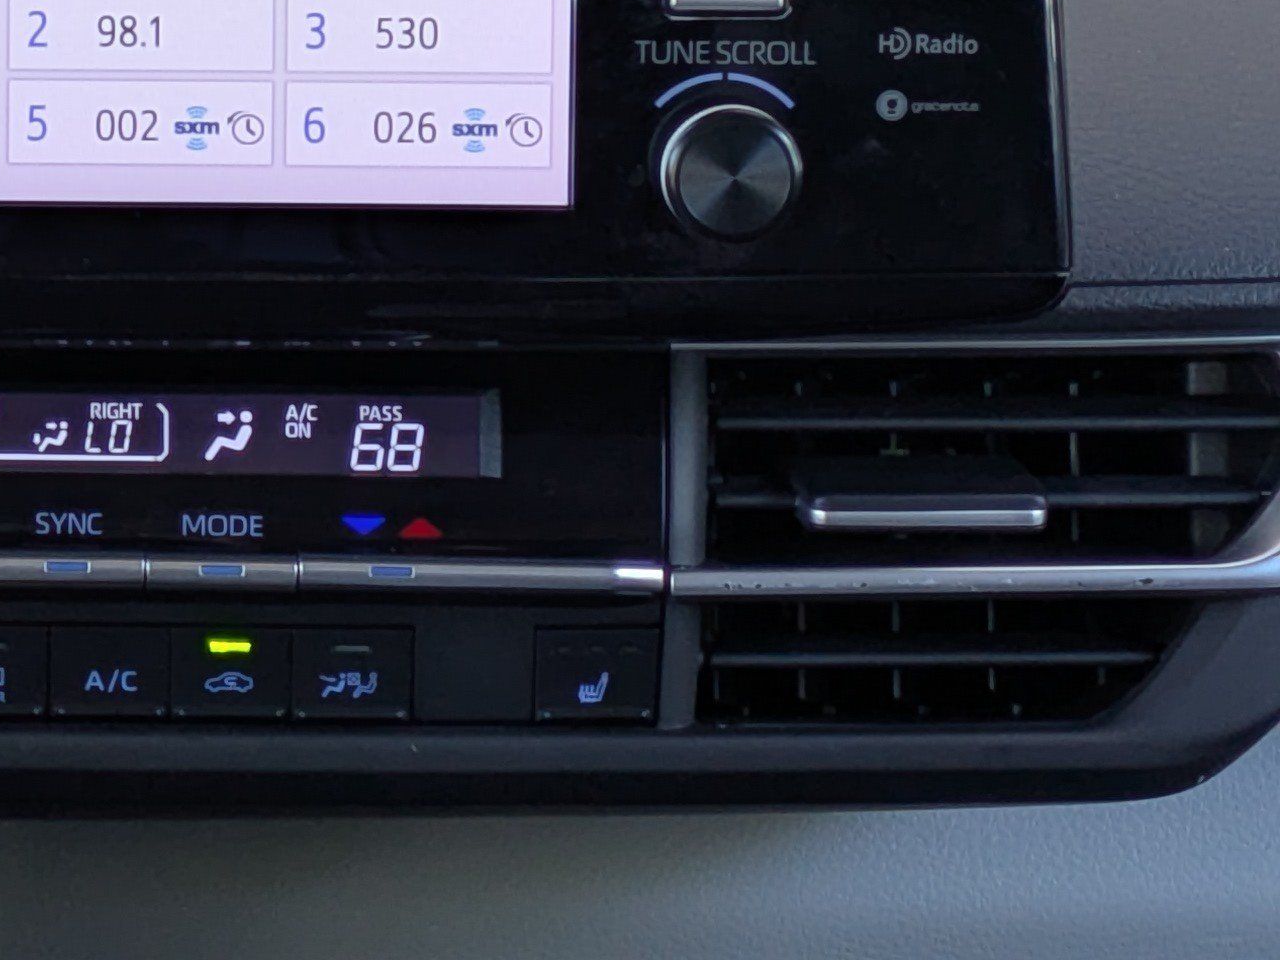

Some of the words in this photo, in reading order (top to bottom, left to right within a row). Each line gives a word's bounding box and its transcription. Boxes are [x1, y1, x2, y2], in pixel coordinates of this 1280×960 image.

[27, 10, 48, 48] 2
[97, 15, 161, 48] 98.1
[305, 12, 326, 50] 3
[376, 17, 439, 50] 530
[634, 39, 709, 65] TUNE
[715, 40, 817, 66] SCROLL
[915, 32, 979, 55] Radio
[27, 104, 47, 142] 5
[95, 109, 159, 142] 002
[303, 106, 326, 144] 6
[373, 111, 437, 144] 026
[89, 402, 143, 420] RIGHT
[285, 402, 318, 422] A/C
[358, 404, 404, 422] PASS
[285, 422, 312, 439] ON
[349, 422, 425, 472] 68
[35, 511, 103, 535] SYNC
[182, 514, 263, 537] MODE
[84, 668, 138, 693] A/C
